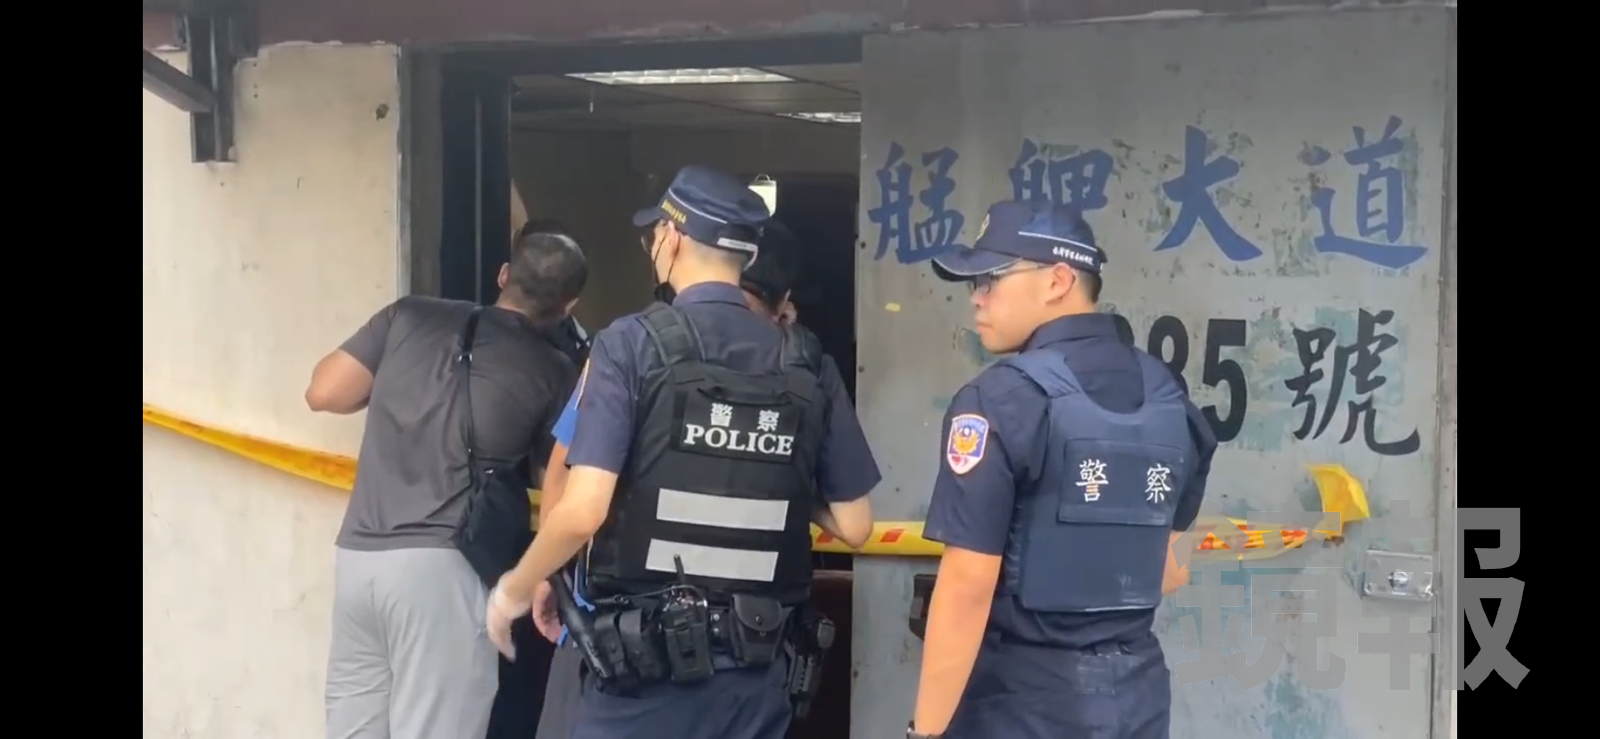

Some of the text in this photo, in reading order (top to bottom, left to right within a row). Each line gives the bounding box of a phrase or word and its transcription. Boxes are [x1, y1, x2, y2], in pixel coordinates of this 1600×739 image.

[867, 115, 1428, 270] 艋舺大道
[1114, 307, 1421, 455] 85號
[683, 423, 795, 456] POLICE
[710, 402, 780, 432] 警察
[1075, 459, 1172, 504] 警察
